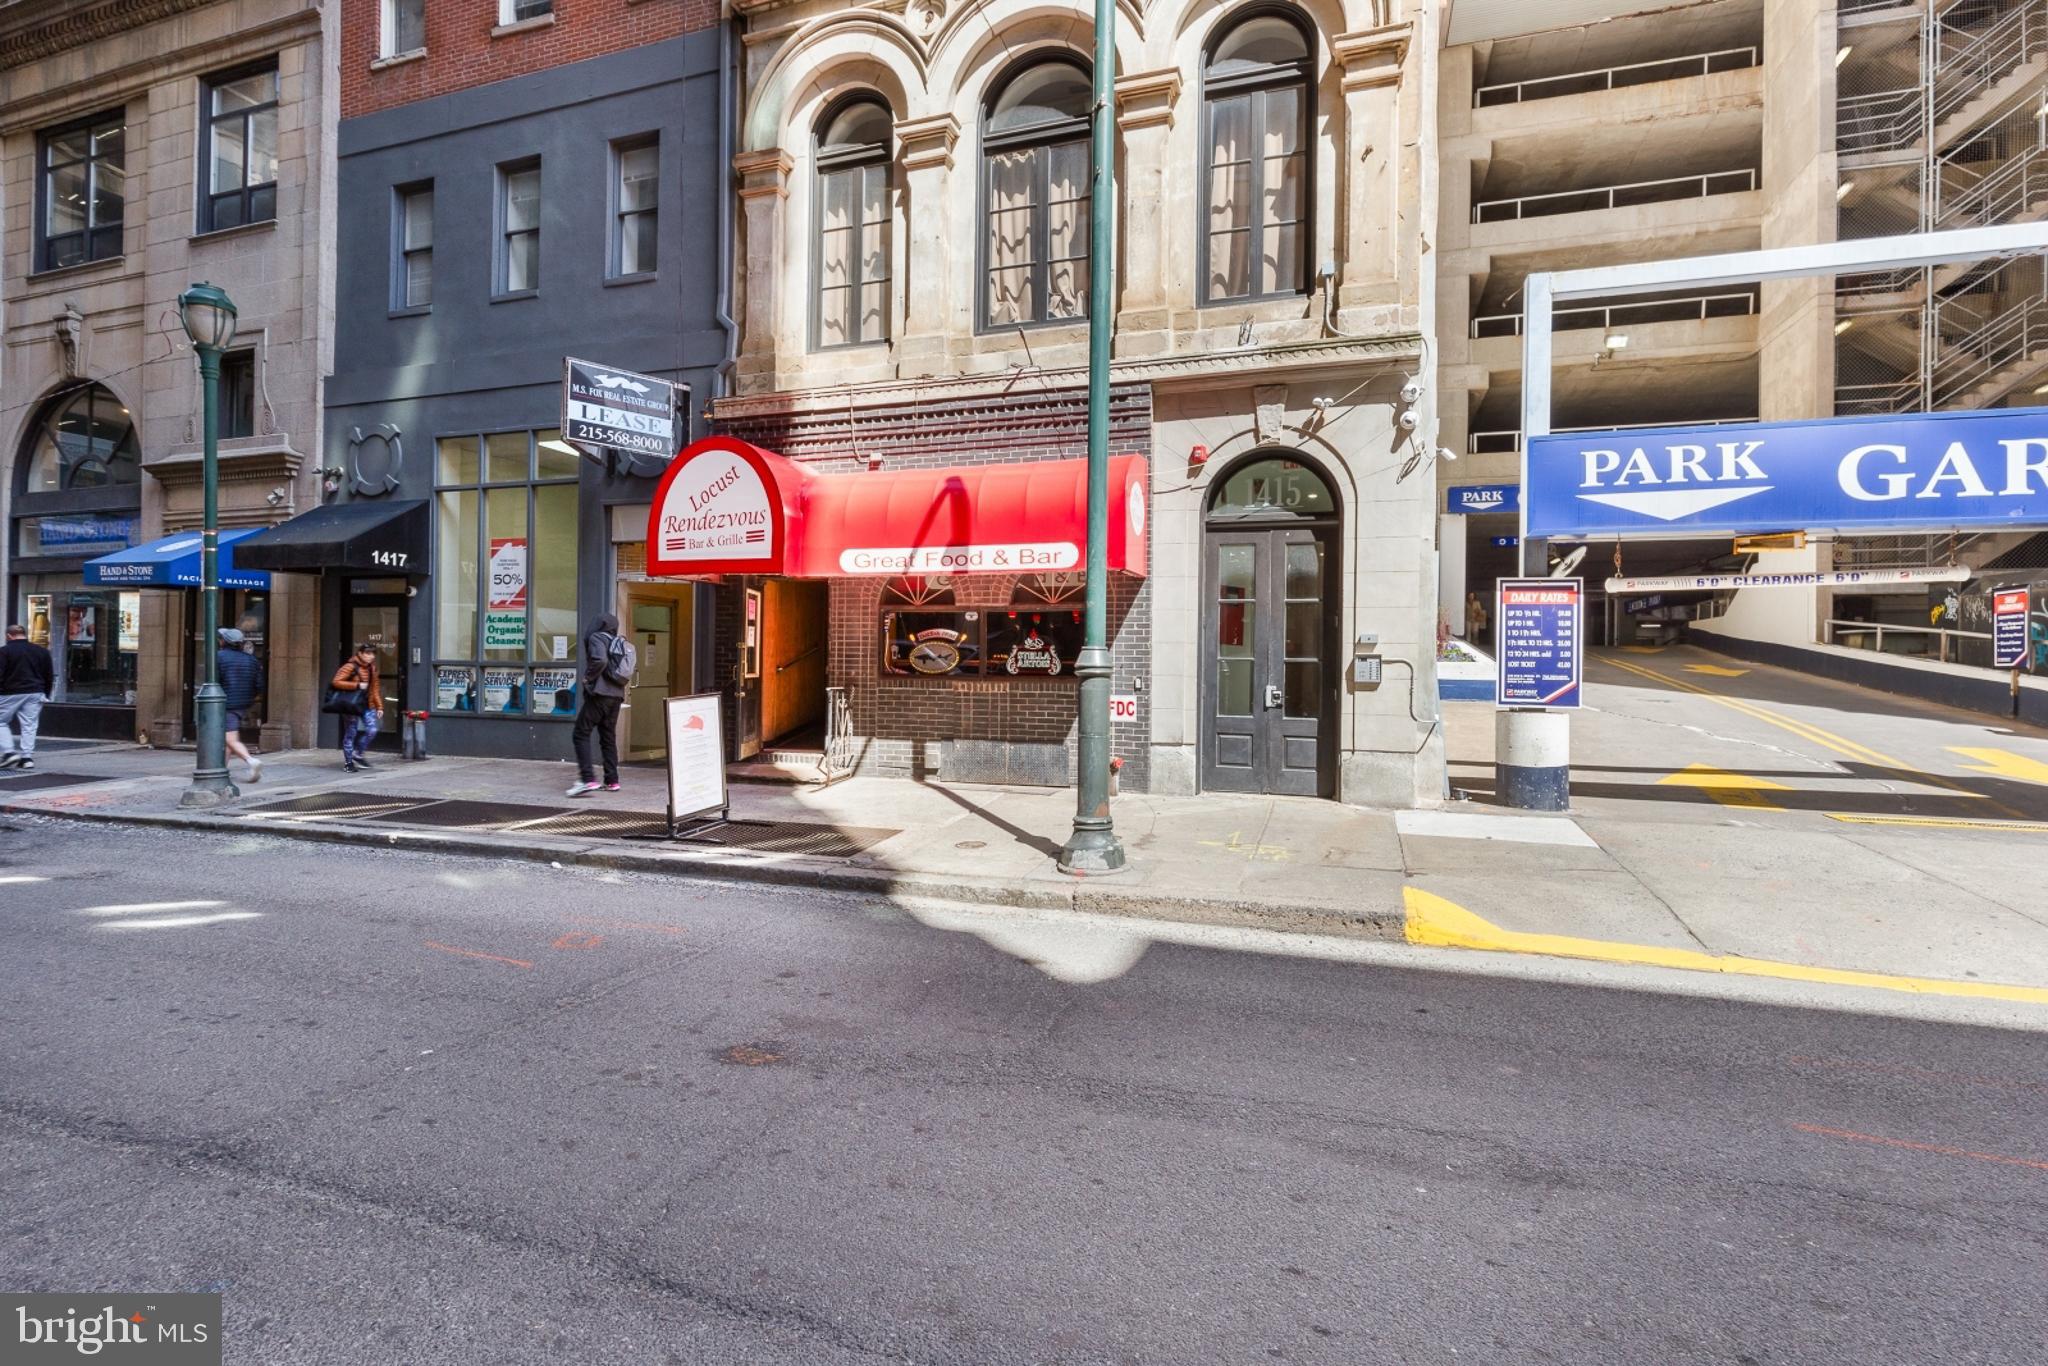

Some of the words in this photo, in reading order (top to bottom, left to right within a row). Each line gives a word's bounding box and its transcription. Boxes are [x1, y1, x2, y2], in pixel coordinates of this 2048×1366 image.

[572, 383, 587, 395] M.S.
[589, 387, 602, 398] FOX
[604, 390, 621, 402] REAL
[622, 395, 646, 407] ESTATE
[647, 400, 669, 412] GROUP
[582, 404, 662, 434] LEASE
[578, 424, 663, 451] 215-568-8000
[1579, 440, 1769, 488] PARK
[689, 465, 741, 512] Locust
[1249, 475, 1300, 506] 1415
[1462, 490, 1504, 502] PARK
[663, 508, 766, 534] Rendezvous
[688, 538, 704, 550] Bar
[706, 537, 715, 548] &
[717, 534, 743, 546] Grille
[371, 550, 408, 567] 1417
[854, 551, 915, 569] Great
[925, 550, 983, 568] Food
[992, 549, 1010, 566] &
[1019, 548, 1062, 565] Bar
[100, 565, 122, 576] HAND
[127, 565, 154, 576] STONE
[225, 578, 265, 587] MASSAGE
[493, 573, 523, 585] 50%
[1733, 573, 1825, 587] CLEARANCE
[1510, 593, 1538, 603] DAILY
[1539, 592, 1569, 603] RATES
[485, 614, 527, 625] Academy
[487, 625, 526, 636] Organic
[1017, 651, 1052, 660] STELLA
[1017, 658, 1051, 668] ARTOIS
[438, 669, 473, 679] EXPRESS
[533, 677, 569, 688] SERVICE!
